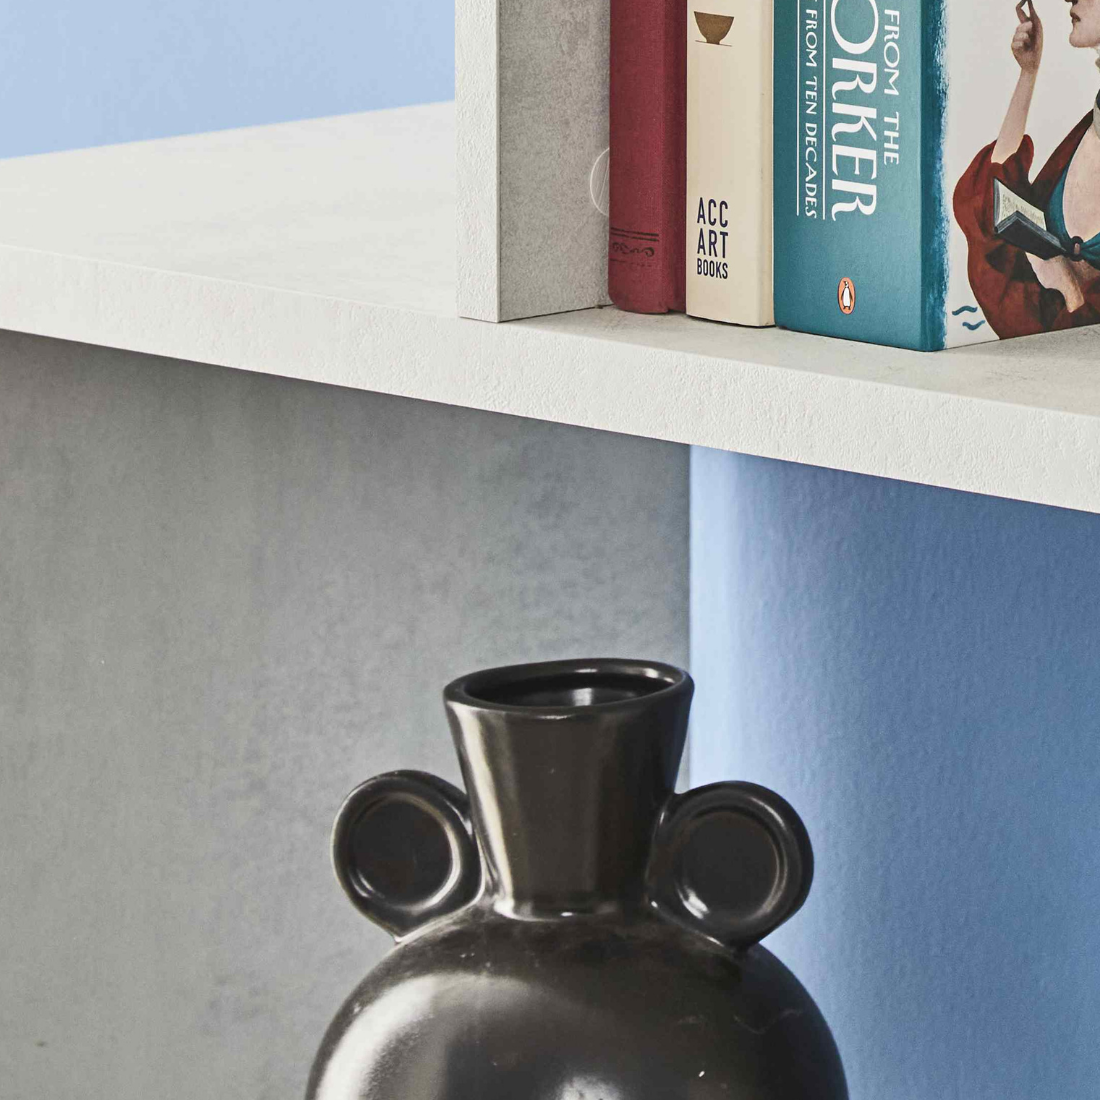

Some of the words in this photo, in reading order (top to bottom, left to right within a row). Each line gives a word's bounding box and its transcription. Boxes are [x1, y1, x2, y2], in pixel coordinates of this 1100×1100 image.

[805, 9, 818, 67] FROM
[884, 9, 900, 96] FROM
[805, 76, 817, 114] TEN
[884, 111, 900, 166] THE
[805, 123, 817, 219] DECADES
[697, 196, 728, 228] ACC
[697, 228, 728, 258] ART
[697, 258, 728, 279] BOOKS
